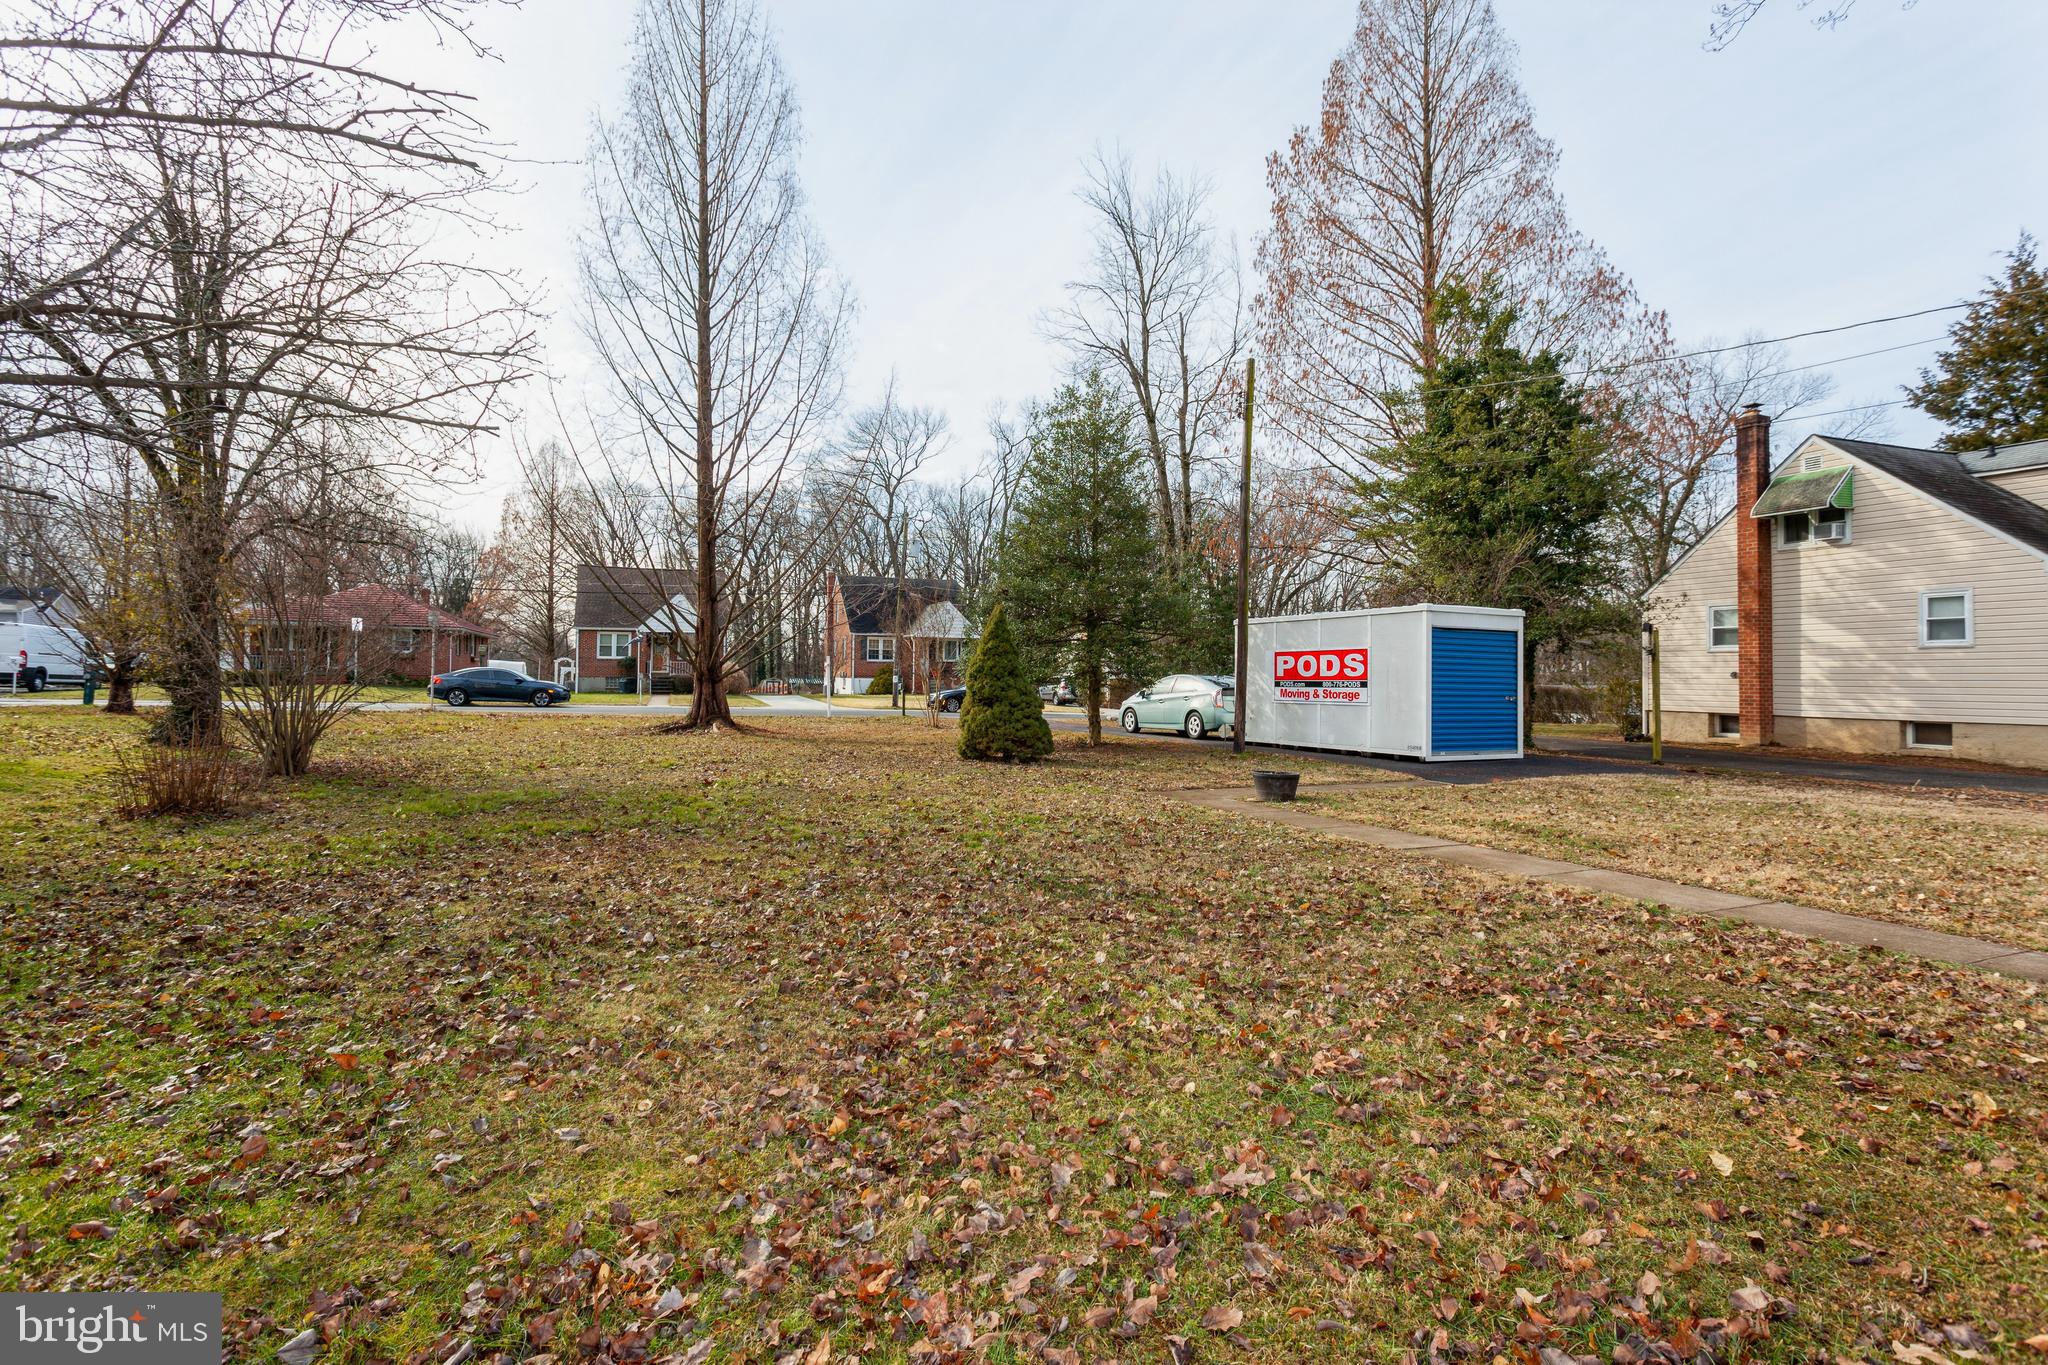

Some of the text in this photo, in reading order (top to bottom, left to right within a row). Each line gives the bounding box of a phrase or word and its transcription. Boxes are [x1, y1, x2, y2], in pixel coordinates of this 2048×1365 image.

[1276, 653, 1365, 677] PODS
[1279, 688, 1361, 701] Moving & Storage
